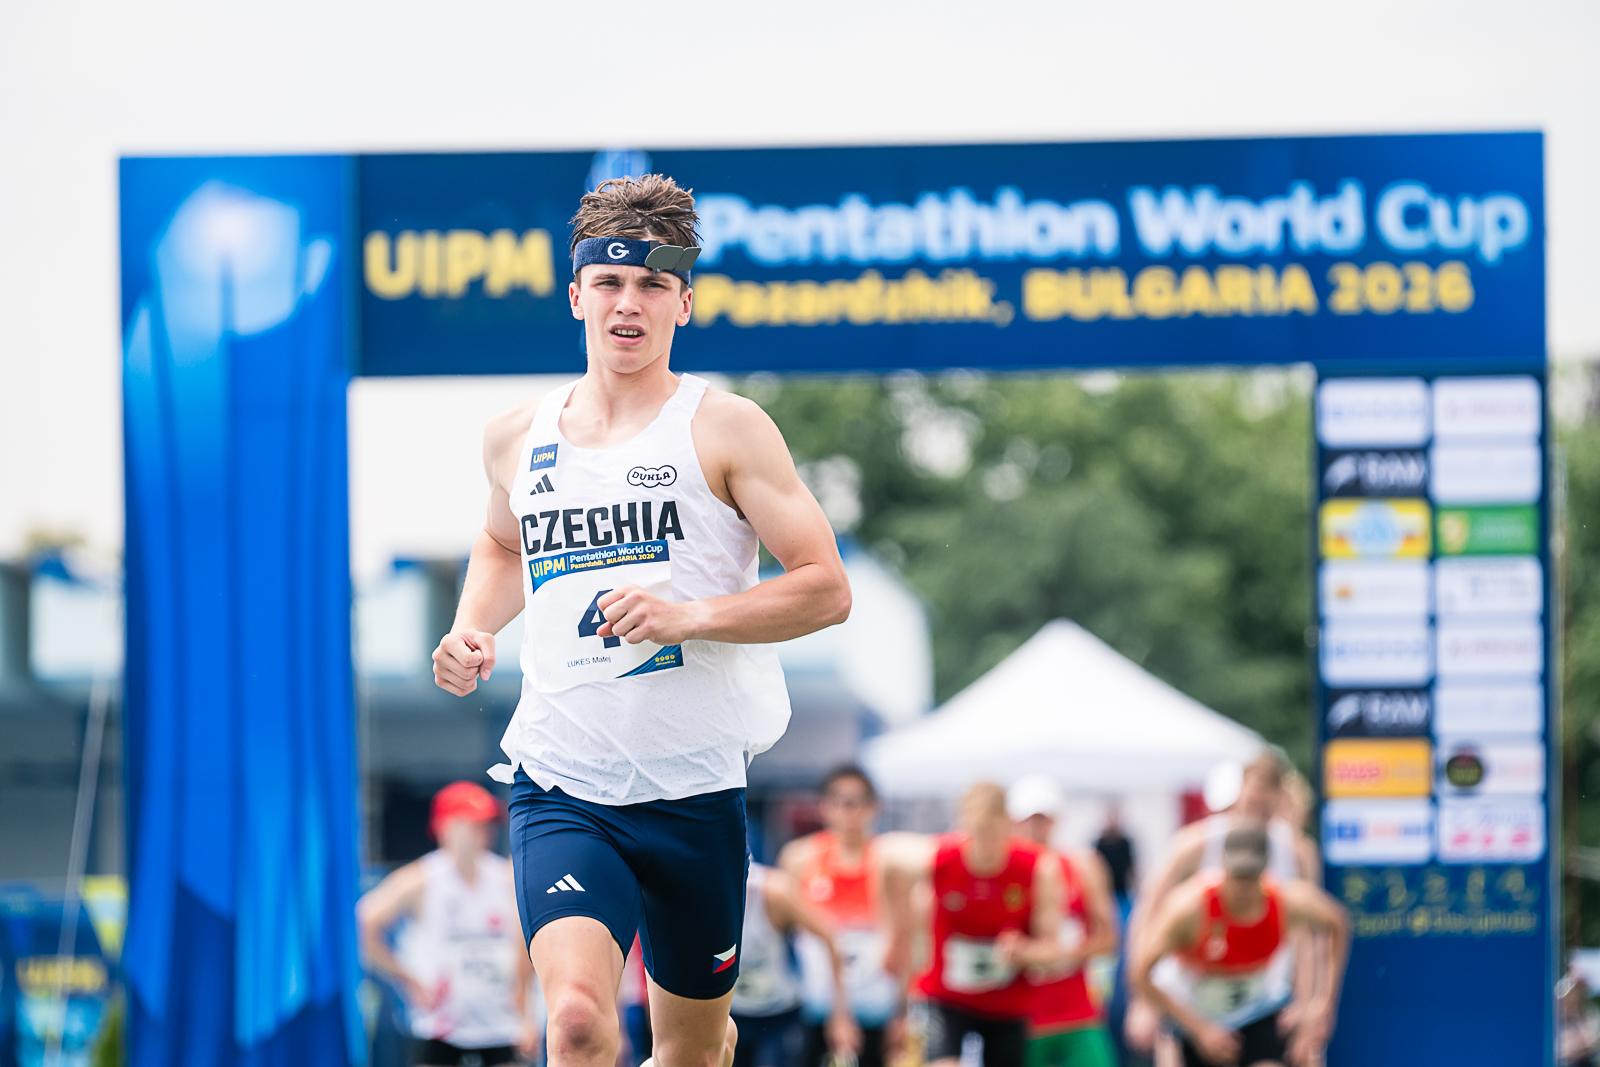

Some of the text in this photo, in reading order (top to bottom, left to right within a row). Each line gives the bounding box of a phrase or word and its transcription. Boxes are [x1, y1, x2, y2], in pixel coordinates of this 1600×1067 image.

[697, 178, 1531, 267] Pentathlon World Cup
[364, 228, 555, 300] UIPM
[1022, 264, 1319, 321] BULGARIA
[1327, 260, 1475, 316] 2026
[533, 451, 555, 464] UIPM
[521, 501, 685, 556] CZECHIA
[531, 557, 566, 578] UIPM
[569, 544, 664, 563] Pentathlon World Cup
[606, 554, 638, 565] BULGARIA
[638, 552, 656, 561] 2026
[578, 588, 622, 649] 4
[566, 655, 612, 668] LUKES Matej
